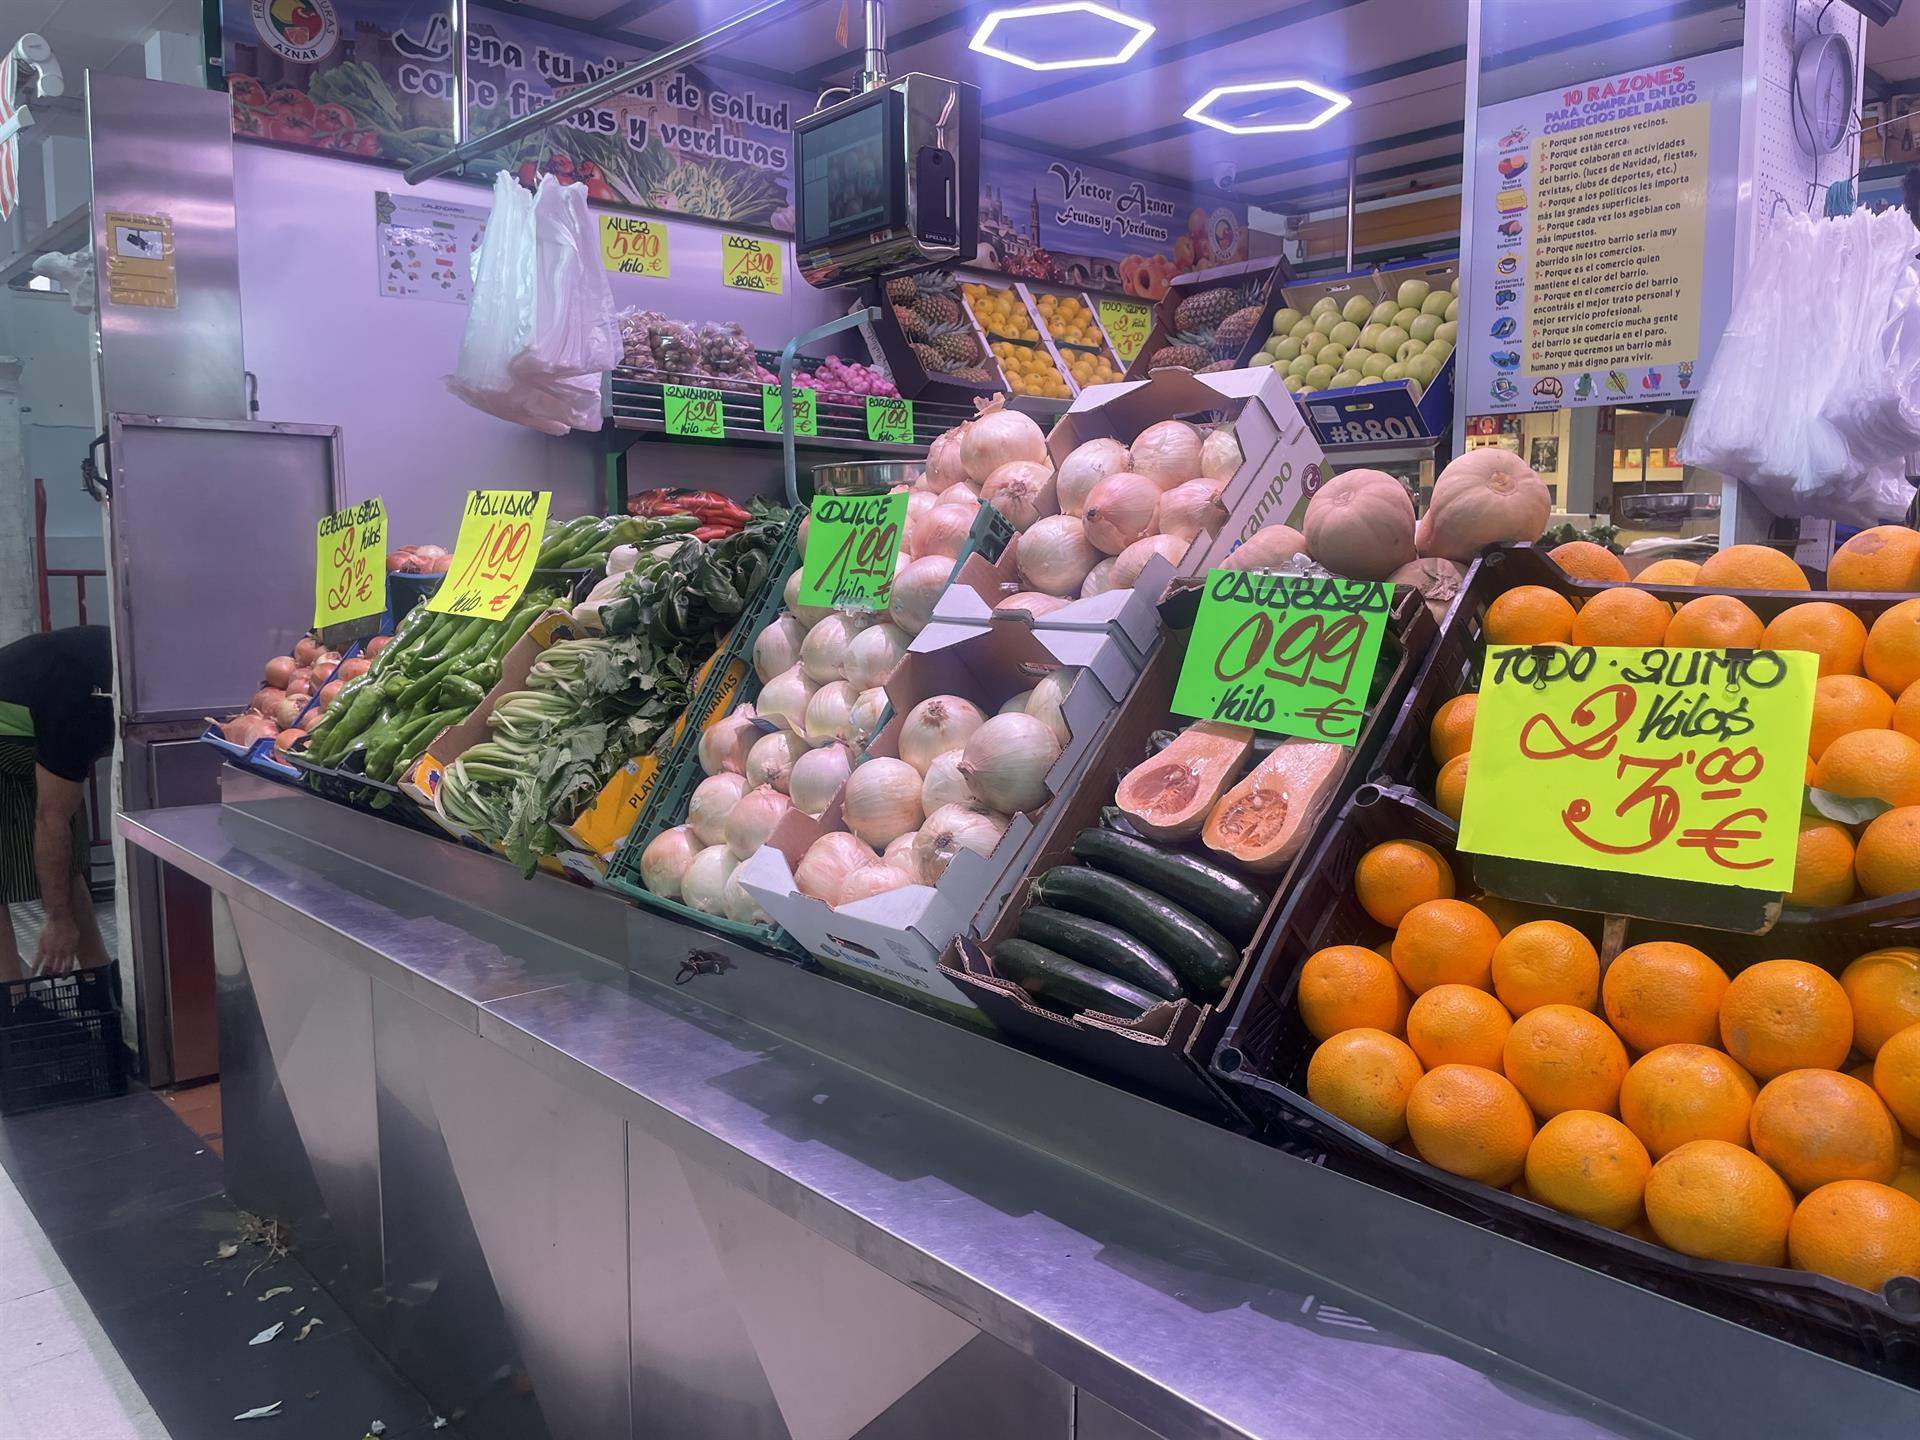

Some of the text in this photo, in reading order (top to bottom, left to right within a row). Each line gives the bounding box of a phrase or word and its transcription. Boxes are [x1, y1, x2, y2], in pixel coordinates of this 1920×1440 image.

[273, 43, 319, 60] AZNAR
[394, 15, 522, 67] Lena
[537, 48, 573, 80] tu
[666, 76, 699, 107] de
[711, 94, 788, 130] salud
[1562, 66, 1685, 107] 10 RAZONES
[1544, 93, 1698, 134] COMERCIOS DEL BARRIO
[1546, 80, 1696, 123] PARA COMPRAR EN LOS
[629, 117, 647, 149] y
[660, 123, 787, 169] verduras
[1549, 136, 1577, 147] Porque
[1578, 133, 1593, 141] son
[1594, 125, 1630, 138] nuestros
[1549, 160, 1577, 170] Porque
[1579, 152, 1620, 165] colaboran
[1634, 139, 1685, 154] actividades
[1550, 148, 1577, 158] Porque
[1539, 175, 1552, 184] del
[1575, 180, 1597, 189] clubs
[1116, 184, 1174, 216] Aznar
[1104, 218, 1112, 232] y
[1116, 216, 1167, 240] Verduras
[1546, 220, 1574, 230] Porque
[1576, 216, 1595, 225] cada
[1628, 205, 1663, 217] agobian
[1664, 202, 1680, 210] con
[649, 258, 662, 272] €
[1544, 268, 1572, 277] Porque
[1595, 258, 1633, 270] comercio
[1636, 255, 1660, 265] quien
[1534, 280, 1569, 290] mantiene
[1581, 275, 1601, 283] calor
[1603, 272, 1617, 280] del
[1543, 291, 1571, 300] Porque
[1594, 282, 1632, 294] comercio
[1635, 280, 1648, 288] del
[1651, 276, 1678, 286] barrio
[1586, 298, 1610, 306] mejor
[1611, 294, 1633, 303] trato
[1635, 289, 1673, 302] personal
[1532, 317, 1555, 325] mejor
[1557, 312, 1589, 322] servicio
[1530, 363, 1559, 371] humano
[1584, 358, 1608, 366] digno
[1610, 356, 1629, 364] para
[1544, 350, 1571, 358] Porque
[1573, 346, 1612, 356] queremos
[1626, 341, 1652, 350] barrio
[467, 494, 538, 518] ITALIANO
[816, 497, 892, 526] DULCE
[334, 527, 355, 568] 2
[356, 574, 372, 602] €
[488, 584, 519, 612] €
[874, 572, 894, 604] €
[1211, 572, 1390, 614] CALABAZA
[1492, 646, 1788, 688] TODO ZUMO
[1295, 698, 1362, 738] €
[1520, 684, 1638, 760] 2
[1676, 808, 1775, 870] €
